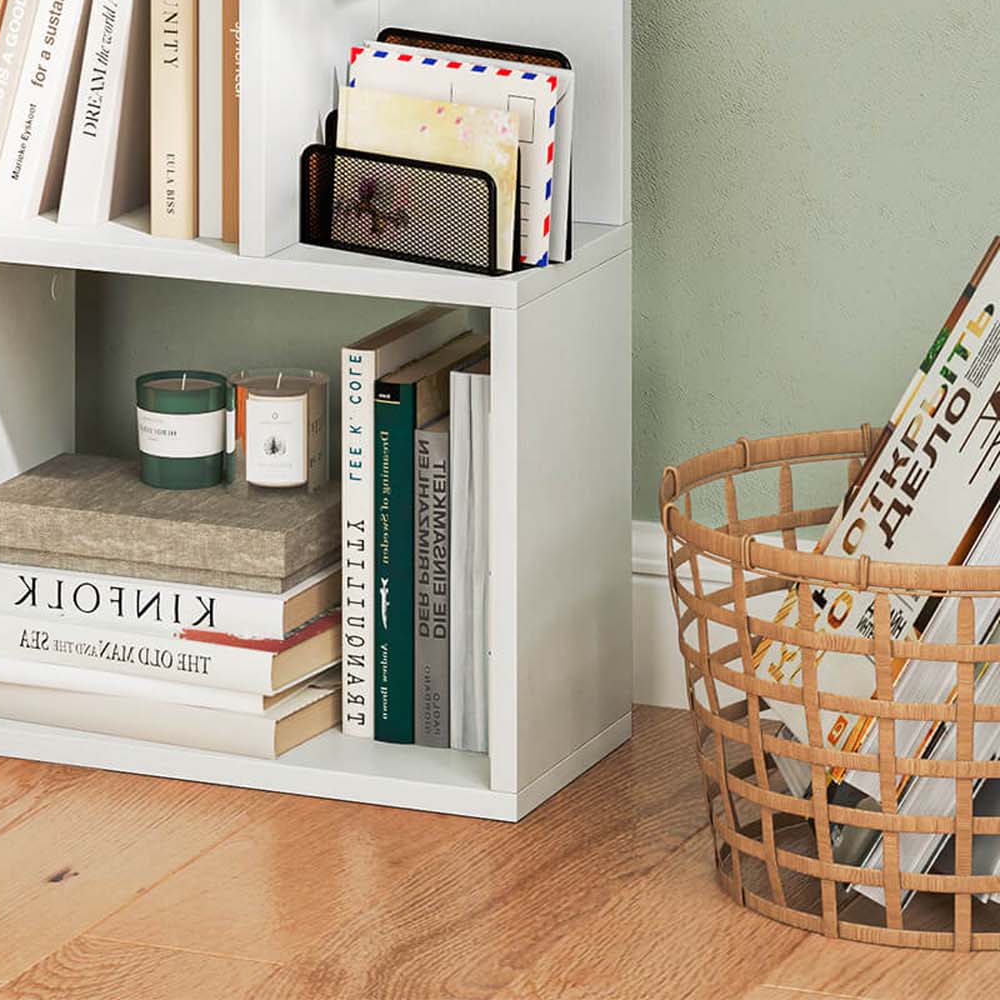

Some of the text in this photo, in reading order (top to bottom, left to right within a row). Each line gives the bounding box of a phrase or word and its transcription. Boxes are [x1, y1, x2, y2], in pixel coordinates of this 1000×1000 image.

[101, 4, 117, 45] world
[31, 63, 48, 88] for
[41, 49, 52, 61] a
[96, 45, 110, 66] the
[83, 67, 106, 138] DREAM
[10, 143, 27, 181] Marieke
[165, 153, 176, 215] EULA BISS
[878, 386, 971, 550] ДЕЛО
